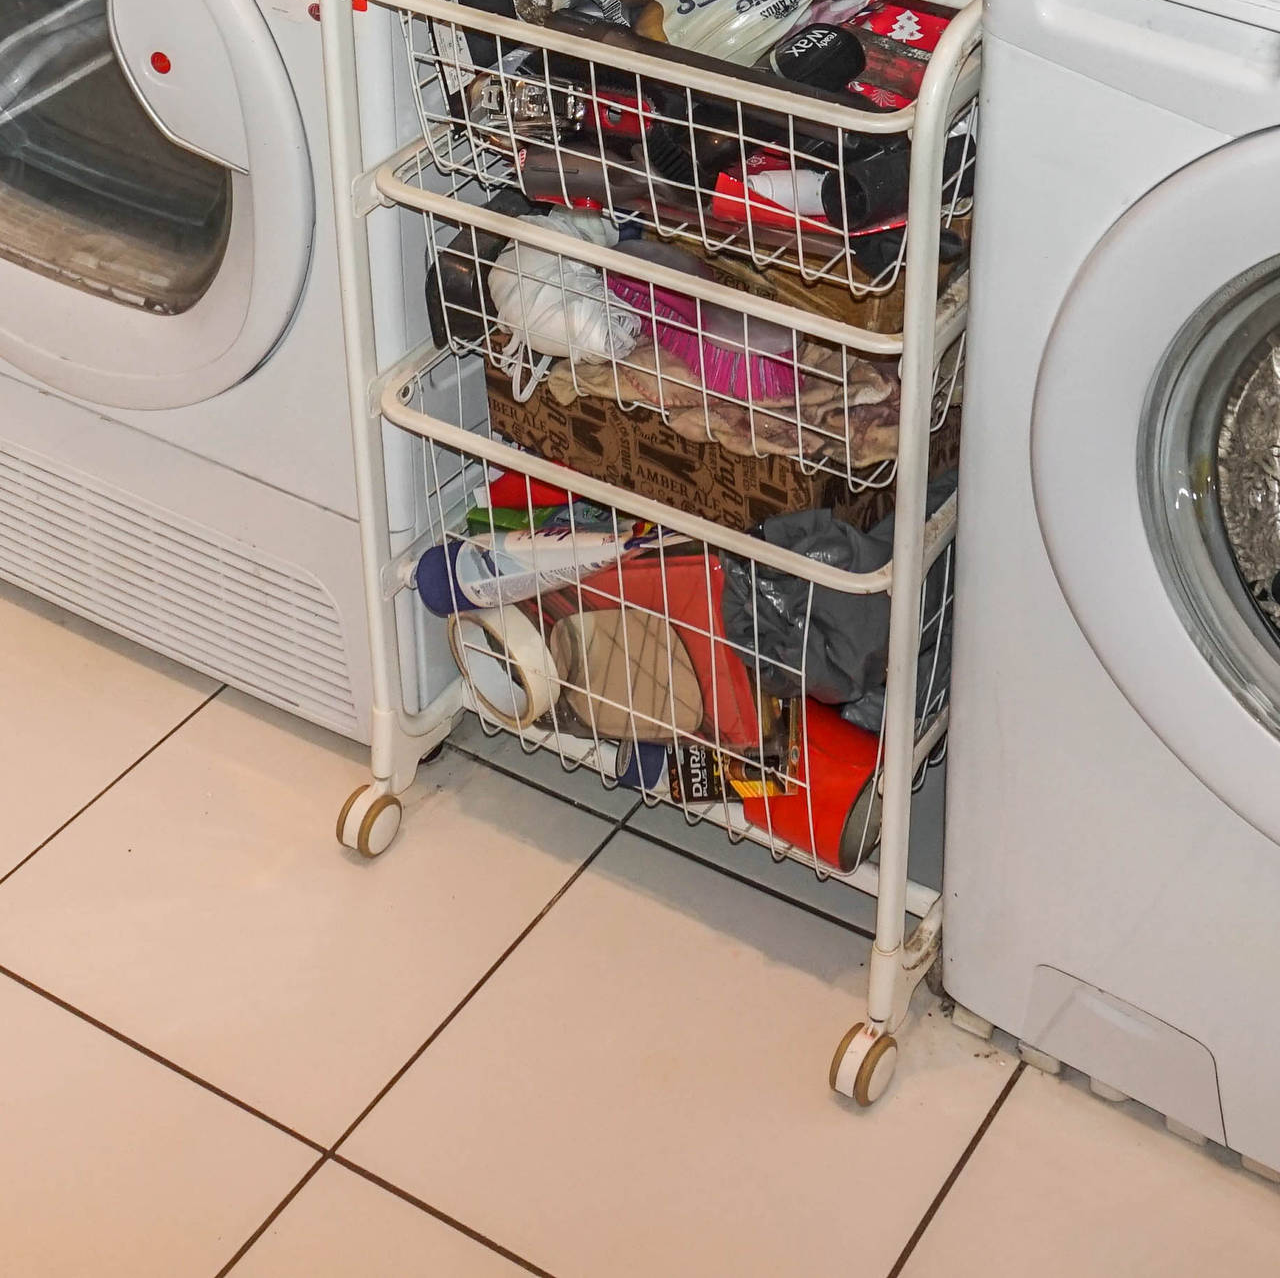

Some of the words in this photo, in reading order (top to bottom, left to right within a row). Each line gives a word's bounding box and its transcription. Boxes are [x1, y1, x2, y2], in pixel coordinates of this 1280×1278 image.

[815, 31, 838, 49] ready
[636, 464, 688, 499] AMBER
[689, 744, 703, 797] DURA
